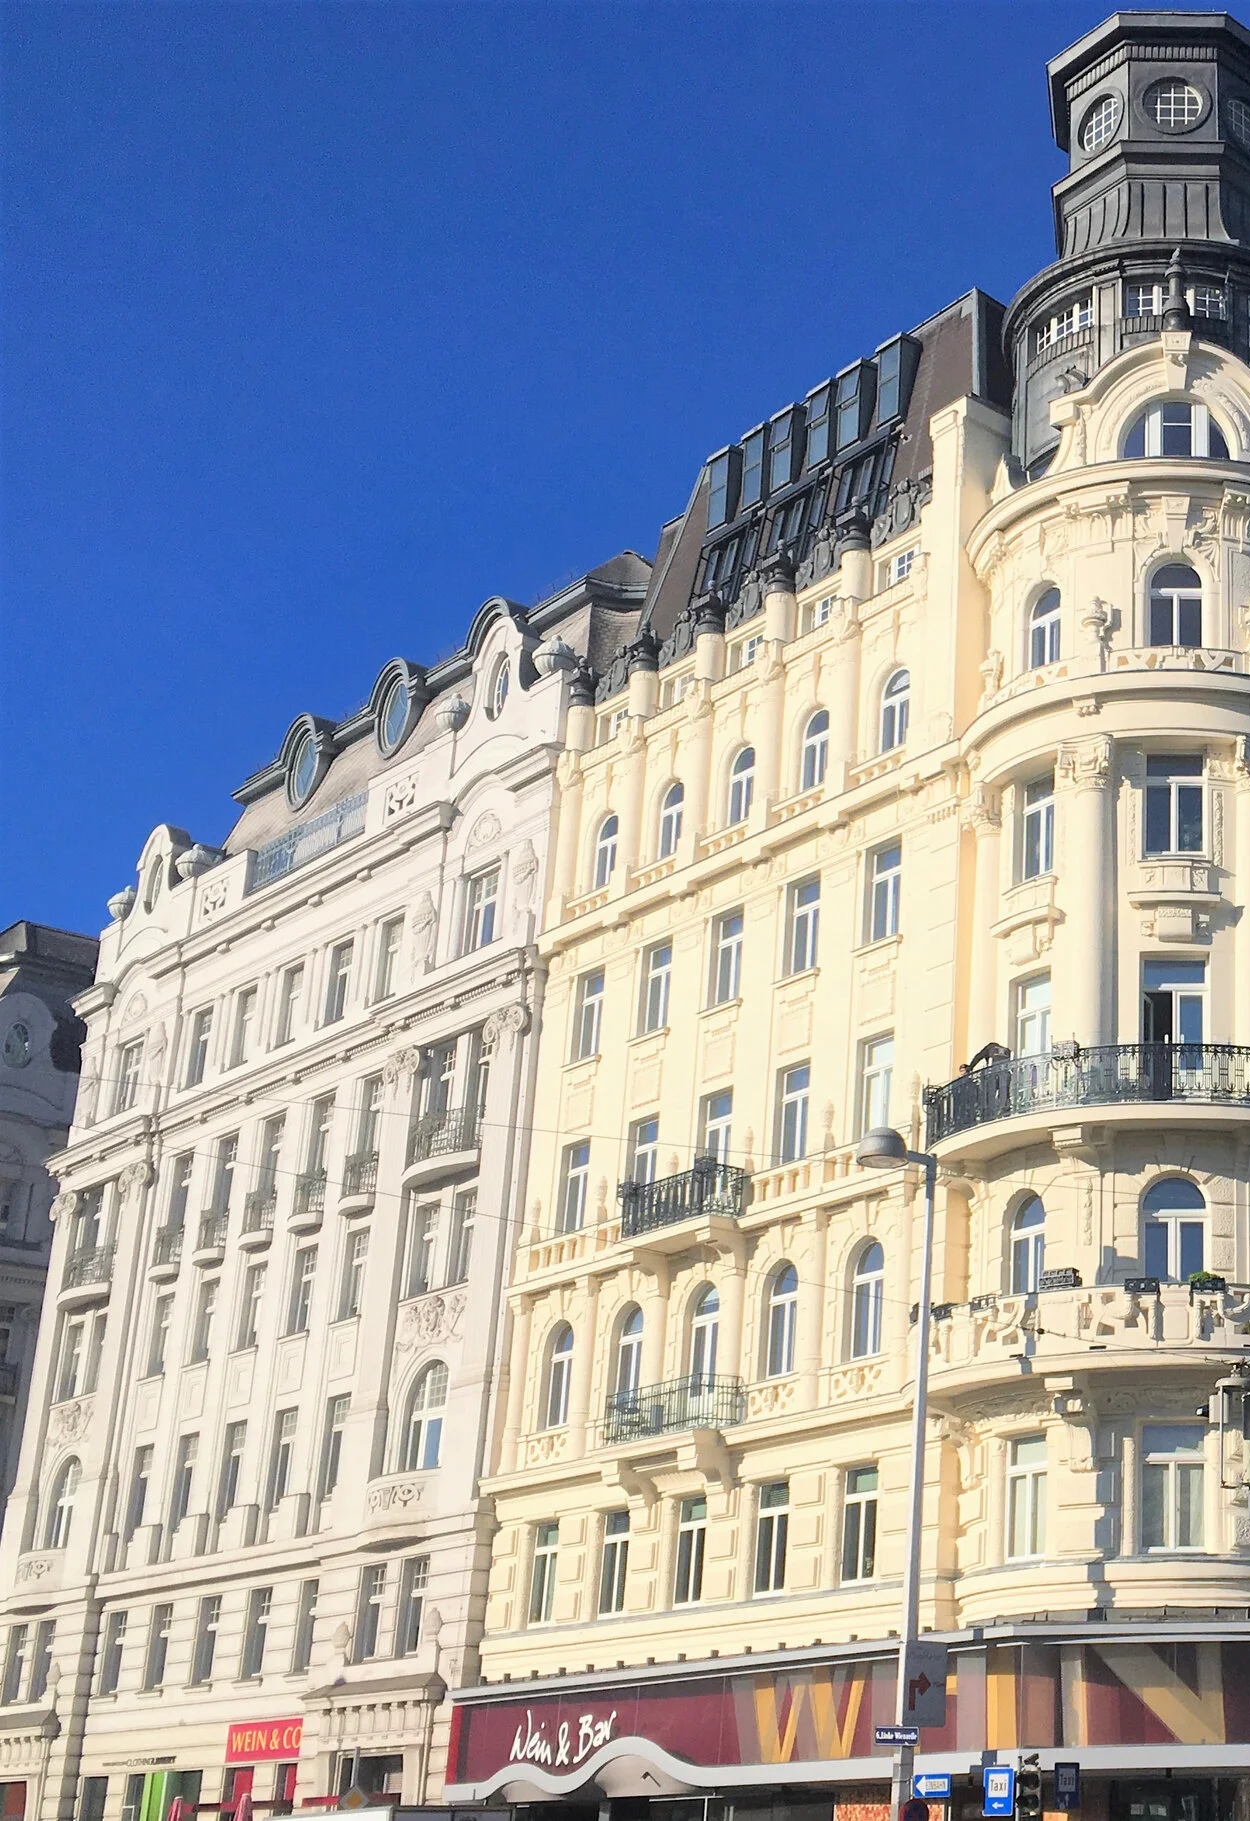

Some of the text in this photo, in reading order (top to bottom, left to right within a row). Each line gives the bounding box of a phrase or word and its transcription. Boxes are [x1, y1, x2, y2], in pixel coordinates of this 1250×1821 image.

[232, 1726, 303, 1753] WEIN & CO
[509, 1709, 617, 1766] Wein & Bar
[990, 1779, 1007, 1792] Taxi
[1058, 1774, 1076, 1787] Taxi
